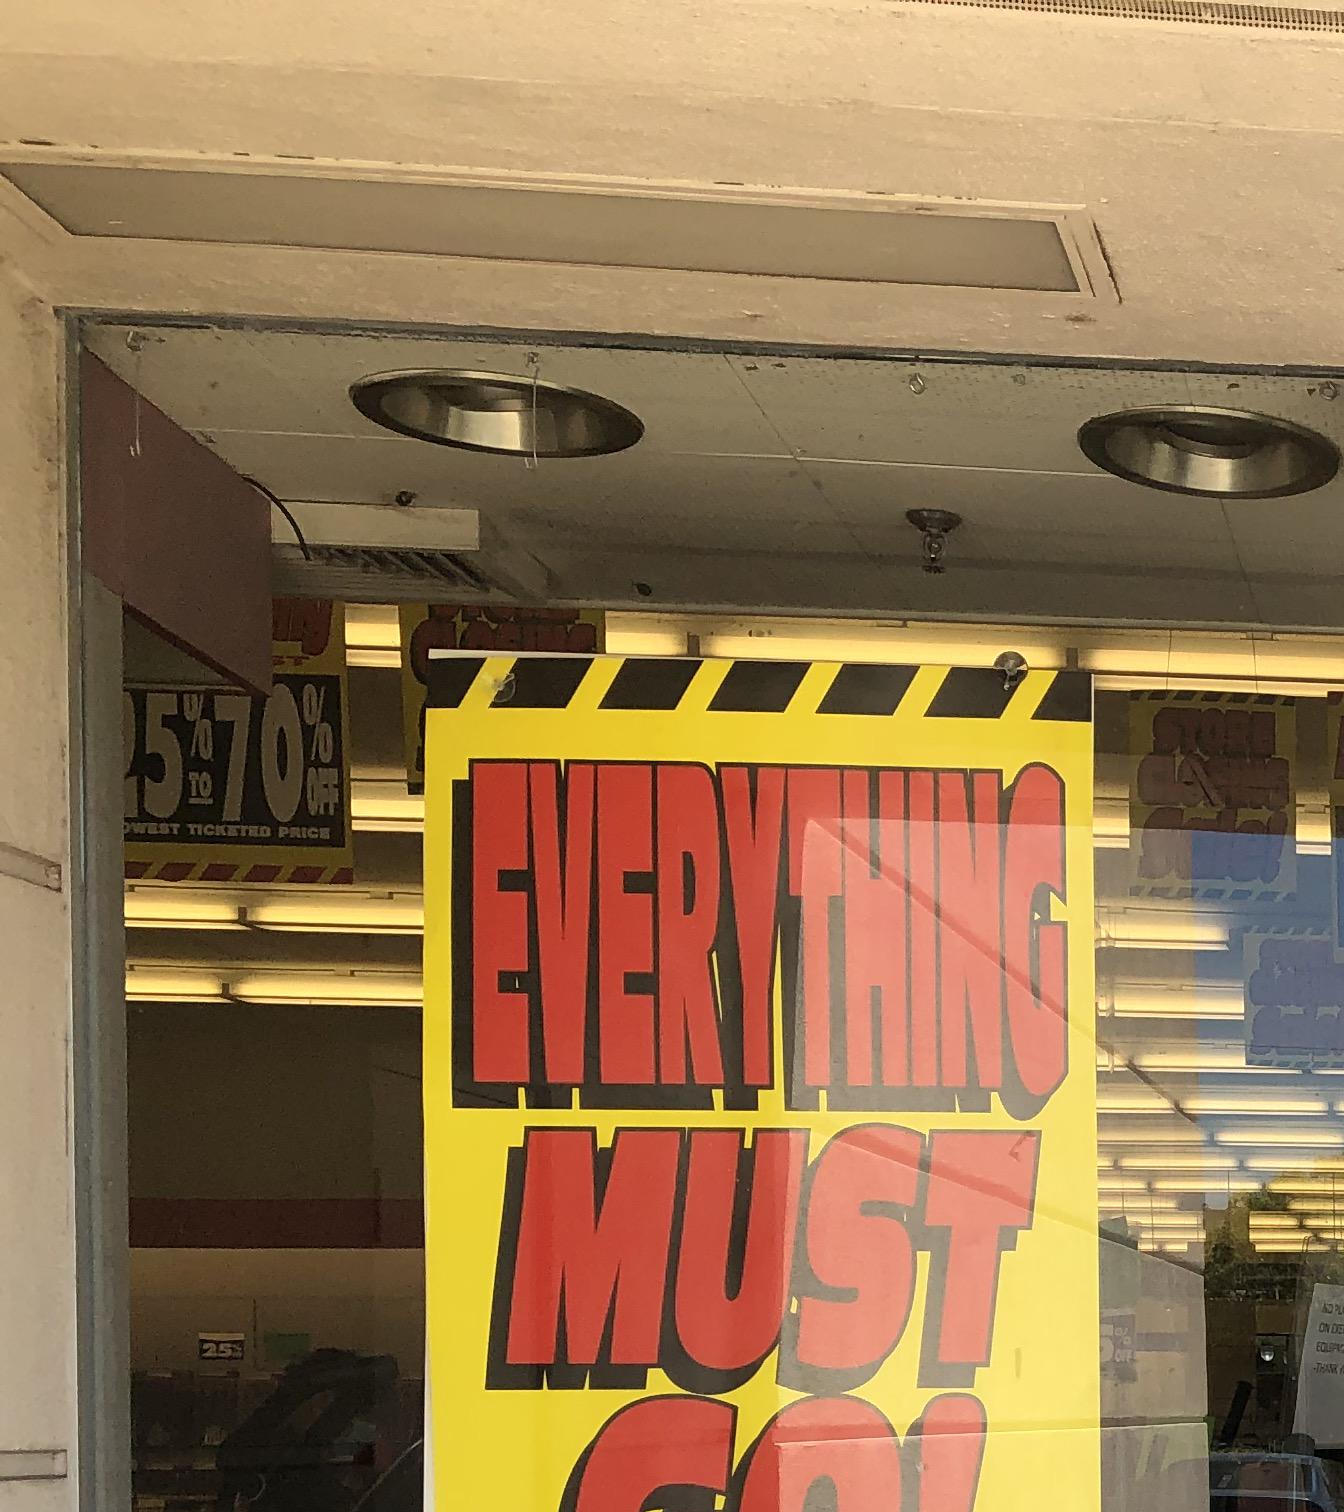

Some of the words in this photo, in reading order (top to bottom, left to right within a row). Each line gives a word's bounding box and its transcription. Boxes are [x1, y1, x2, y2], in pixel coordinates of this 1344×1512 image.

[189, 823, 272, 838] TICKETED
[278, 826, 331, 840] PRICE
[452, 758, 1069, 1120] EVERYTHING
[485, 1123, 1042, 1394] MUST
